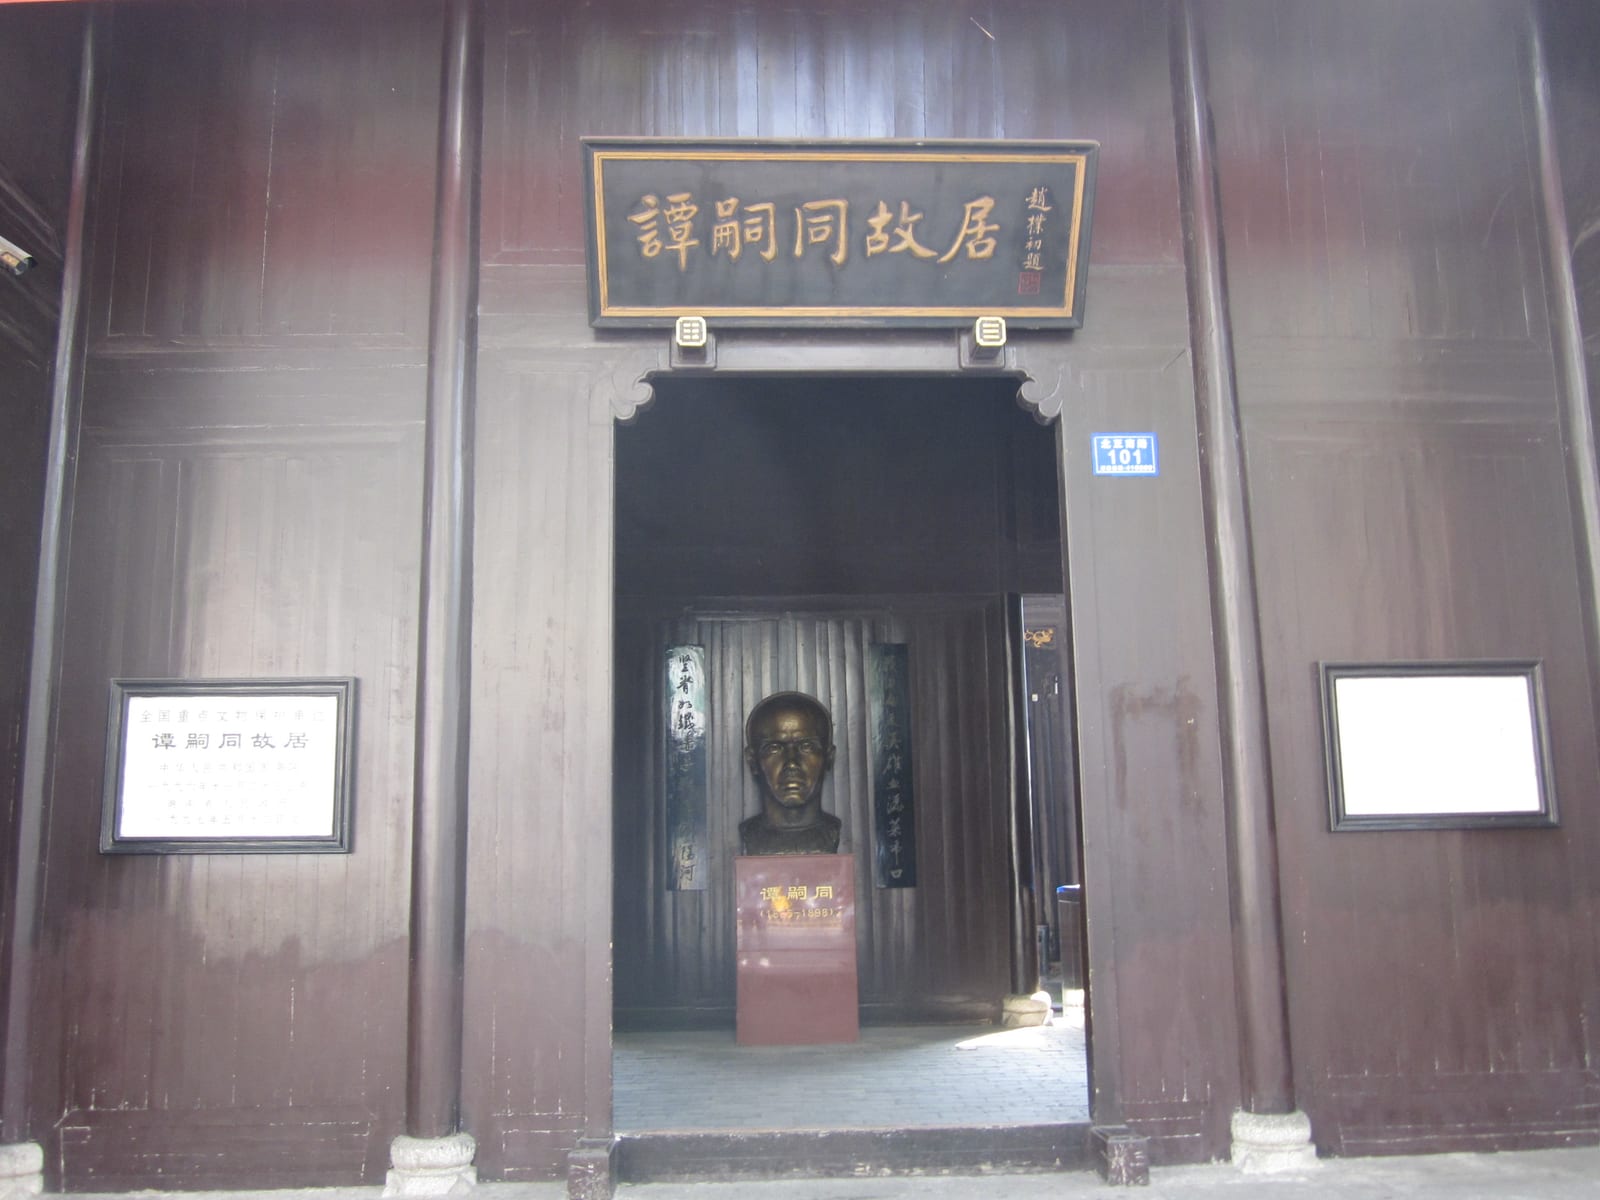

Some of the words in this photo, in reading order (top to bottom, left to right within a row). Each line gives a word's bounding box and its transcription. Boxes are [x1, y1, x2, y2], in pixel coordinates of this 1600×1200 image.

[628, 192, 1000, 271] 譚嗣同故居
[1107, 449, 1141, 465] 101
[152, 732, 309, 750] 谭嗣同故居
